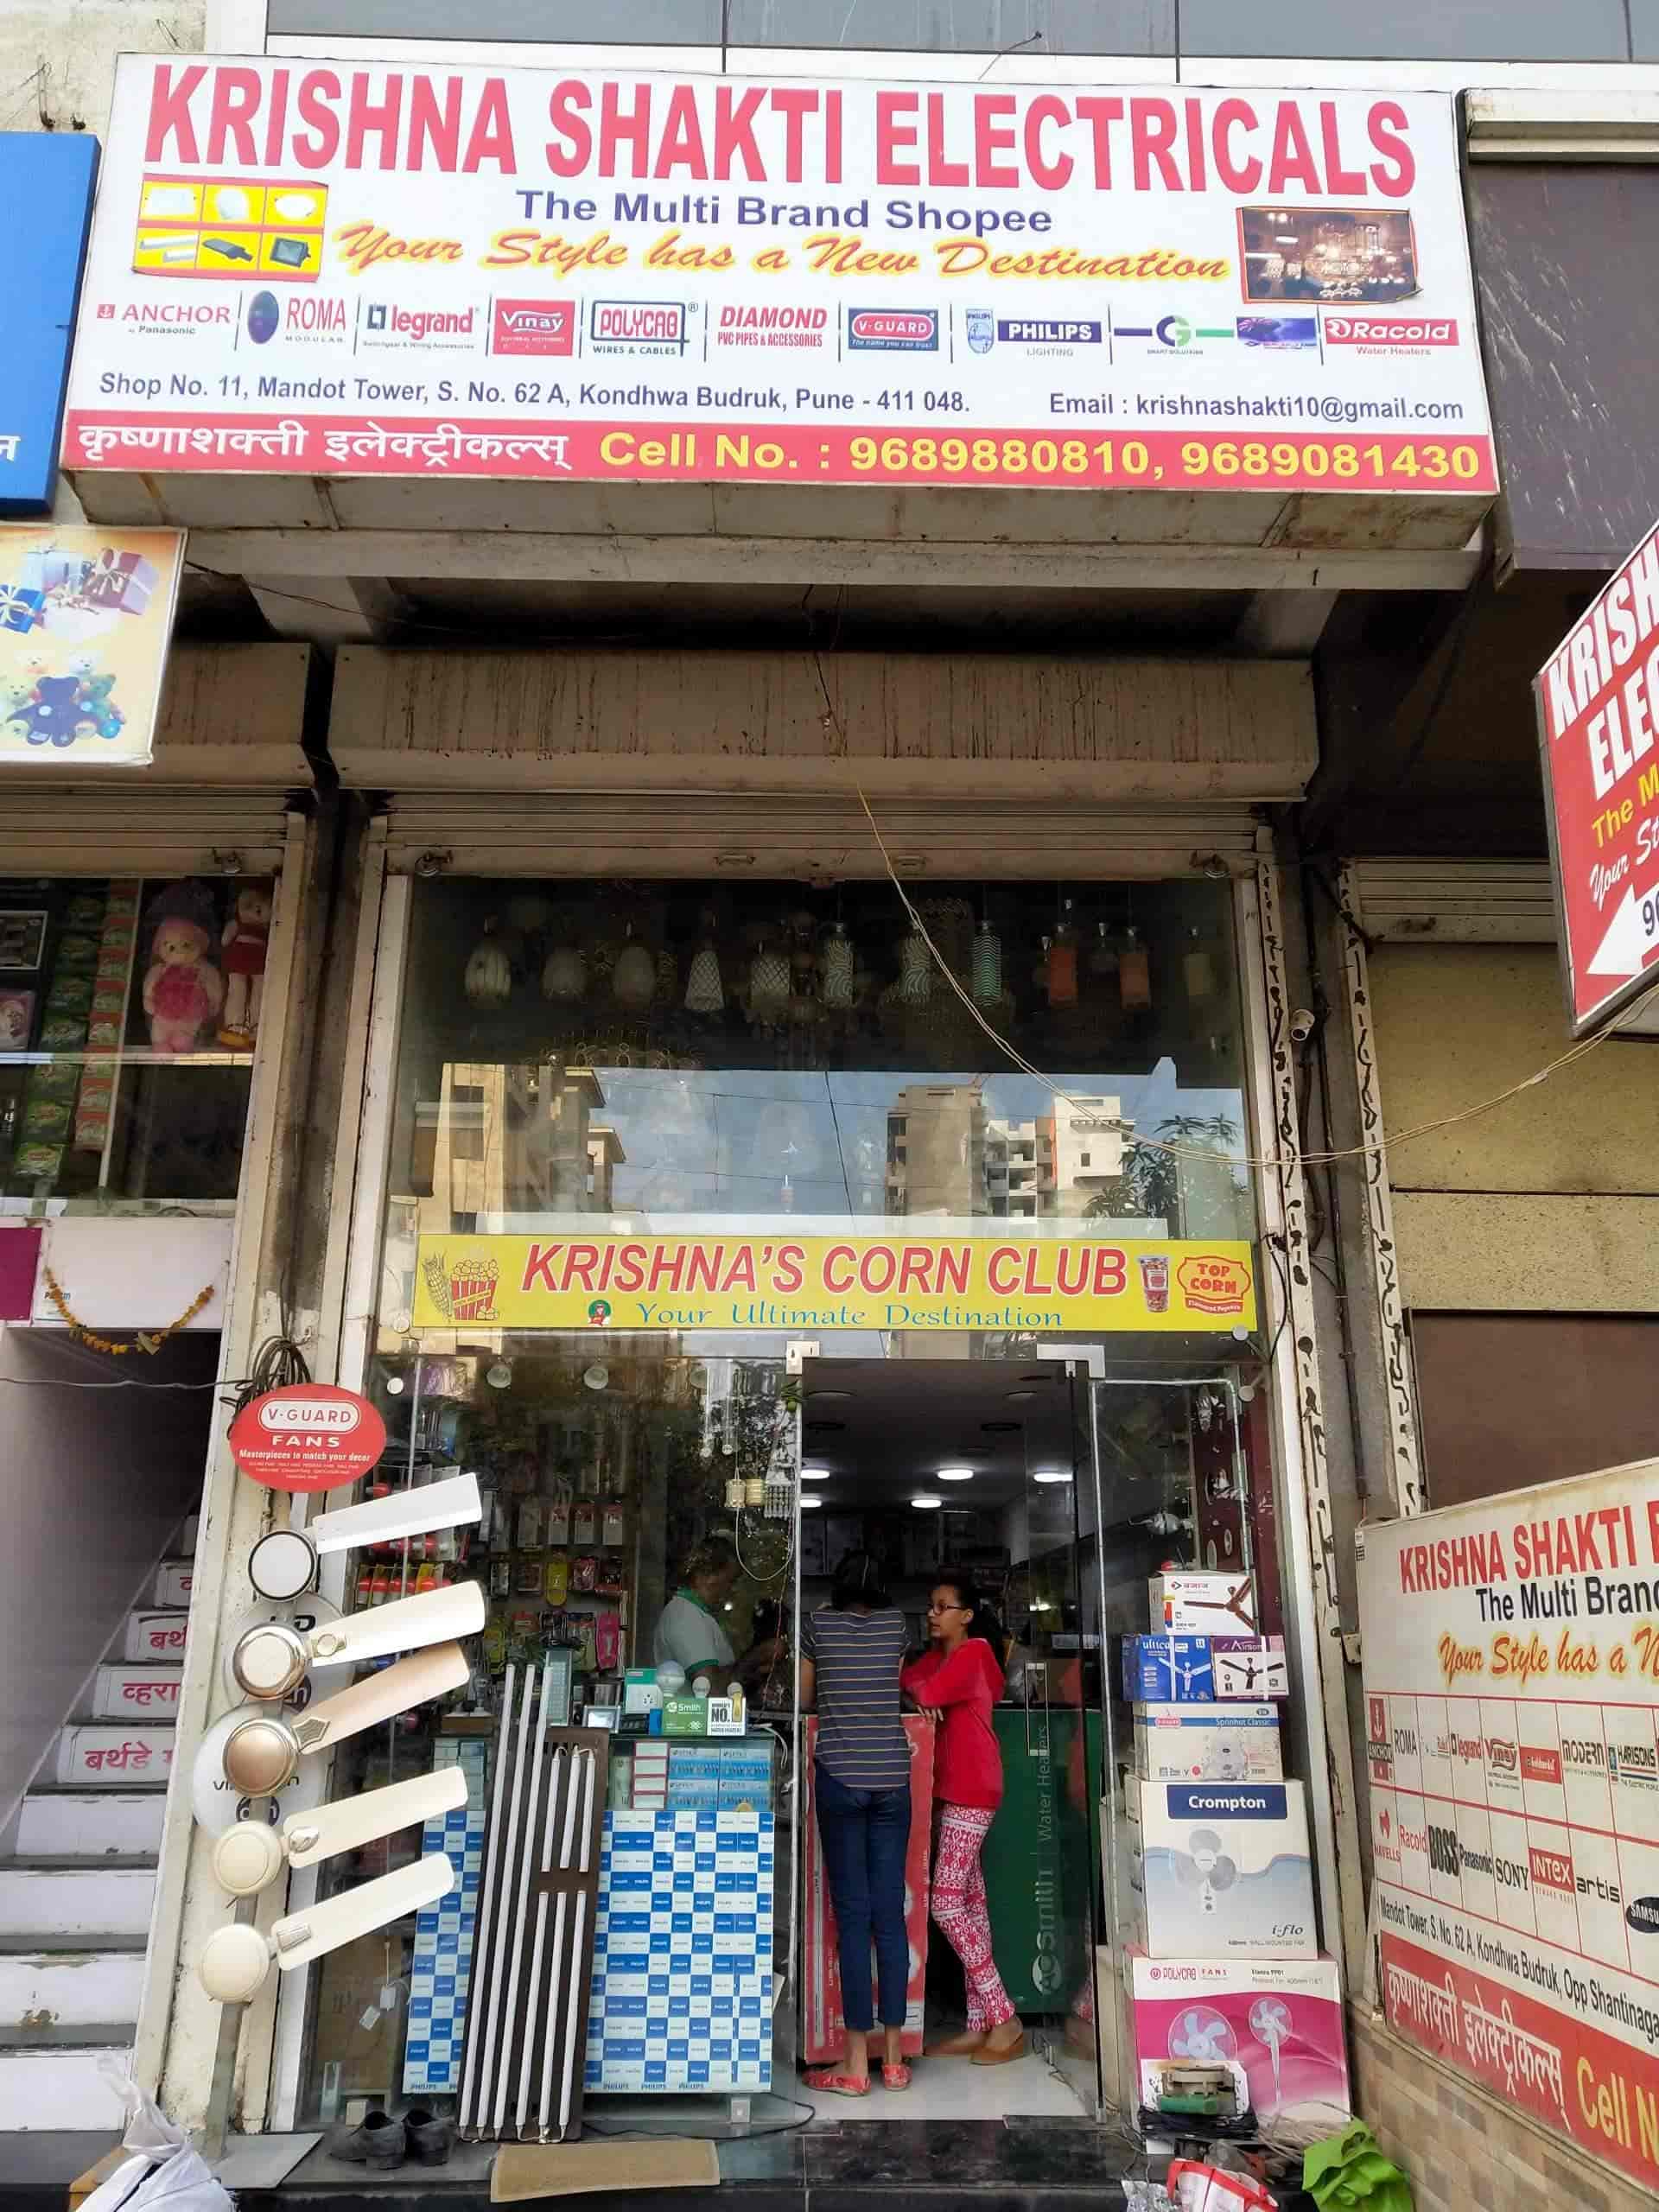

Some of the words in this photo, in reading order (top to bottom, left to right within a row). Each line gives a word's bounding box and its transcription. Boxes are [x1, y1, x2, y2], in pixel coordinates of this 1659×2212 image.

[143, 64, 517, 174] KRISHNA
[545, 79, 842, 184] SHAKTI
[876, 90, 1416, 198] ELECTRICALS
[516, 189, 597, 221] The
[613, 193, 720, 225] Multi
[737, 195, 868, 229] Brand
[886, 200, 1052, 238] Shopee
[337, 223, 465, 270] Your
[484, 231, 631, 274] Style
[648, 232, 736, 269] has
[755, 247, 790, 270] a
[805, 237, 919, 272] New
[936, 240, 1228, 278] Destination
[122, 304, 231, 324] ANCHOR
[286, 297, 346, 331] ROMA
[391, 305, 474, 340] legrand
[500, 310, 563, 334] Vinay
[600, 308, 678, 338] POLYCAB
[719, 305, 828, 329] DIAMOND
[857, 320, 928, 334] V-GUARD
[138, 326, 196, 335] Panasonic
[717, 331, 734, 345] PVC
[736, 332, 758, 346] PIPES
[767, 333, 823, 346] ACCESSORIES
[1007, 322, 1093, 340] PHILIPS
[1354, 321, 1452, 341] Racold
[593, 346, 624, 354] WIRES
[628, 346, 635, 355] &
[639, 346, 677, 355] CABLES
[1027, 347, 1074, 358] LIGHTING
[1357, 346, 1387, 355] Water
[1389, 346, 1432, 356] Heaters
[99, 372, 162, 400] Shop
[169, 375, 208, 397] No.
[218, 376, 249, 399] 11,
[257, 376, 346, 399] Mandot
[354, 378, 429, 404] Tower,
[437, 381, 459, 402] S.
[468, 381, 505, 404] No.
[514, 383, 540, 404] 62
[547, 384, 570, 407] A,
[580, 384, 689, 406] Kondhwa
[696, 386, 788, 412] Budruk,
[795, 388, 855, 410] Pune
[877, 390, 914, 410] 411
[924, 391, 970, 412] 048.
[1050, 392, 1114, 415] Email
[1137, 393, 1464, 423] krishnashakti10@gmail.com
[79, 420, 309, 462] कृष्णाशक्ती
[600, 432, 696, 467] Cell
[715, 434, 798, 469] No.
[849, 436, 1166, 480] 9689880810,
[1180, 442, 1480, 479] 9689081430
[1592, 798, 1634, 848] The
[1589, 854, 1630, 912] Your
[1642, 888, 1659, 937] 9
[518, 1243, 805, 1294] KRISHNA'S
[822, 1244, 972, 1296] CORN
[987, 1246, 1128, 1296] CLUB
[1197, 1262, 1230, 1277] TOP
[1190, 1277, 1237, 1294] CORN
[636, 1301, 713, 1325] Your
[731, 1300, 866, 1326] Ultimate
[884, 1303, 1064, 1327] Destination
[268, 1408, 352, 1424] V-GUARD
[238, 1448, 291, 1461] Masterpieces
[302, 1451, 327, 1460] match
[328, 1452, 347, 1462] your
[348, 1452, 371, 1462] decor
[272, 1435, 340, 1448] FANS
[1399, 1530, 1508, 1594] KRISHNA
[1513, 1505, 1637, 1580] SHAKTI
[1476, 1587, 1515, 1623] The
[1520, 1578, 1578, 1620] Multi
[1438, 1634, 1484, 1686] Your
[1490, 1633, 1550, 1685] Style
[1556, 1630, 1599, 1674] has
[1609, 1644, 1628, 1675] a
[711, 1707, 731, 1723] NO.
[1036, 1725, 1052, 1787] Heaers
[1395, 1728, 1418, 1756] ROMA
[1484, 1738, 1517, 1771] Vinay
[1561, 1738, 1605, 1767] MODERN
[1617, 1744, 1656, 1768] HARISONS
[1037, 1791, 1052, 1842] Water
[1188, 1795, 1267, 1812] Crompton
[1400, 1824, 1427, 1853] Racold
[1428, 1824, 1459, 1877] BOSS
[1459, 1843, 1494, 1875] Panasonic
[1495, 1857, 1529, 1891] SONY
[1576, 1876, 1621, 1904] artis
[1271, 1923, 1304, 1937] i-flo
[1380, 1893, 1406, 1926] Mandot
[1406, 1904, 1430, 1942] Tower,
[1440, 1917, 1454, 1948] No.
[1455, 1924, 1465, 1953] 62
[1476, 1932, 1520, 1977] Kondhwa
[1521, 1950, 1563, 2001] Budruk,
[1563, 1967, 1588, 2012] Opp
[1163, 1967, 1197, 1980] POLYCAB
[1576, 2056, 1632, 2150] Cell
